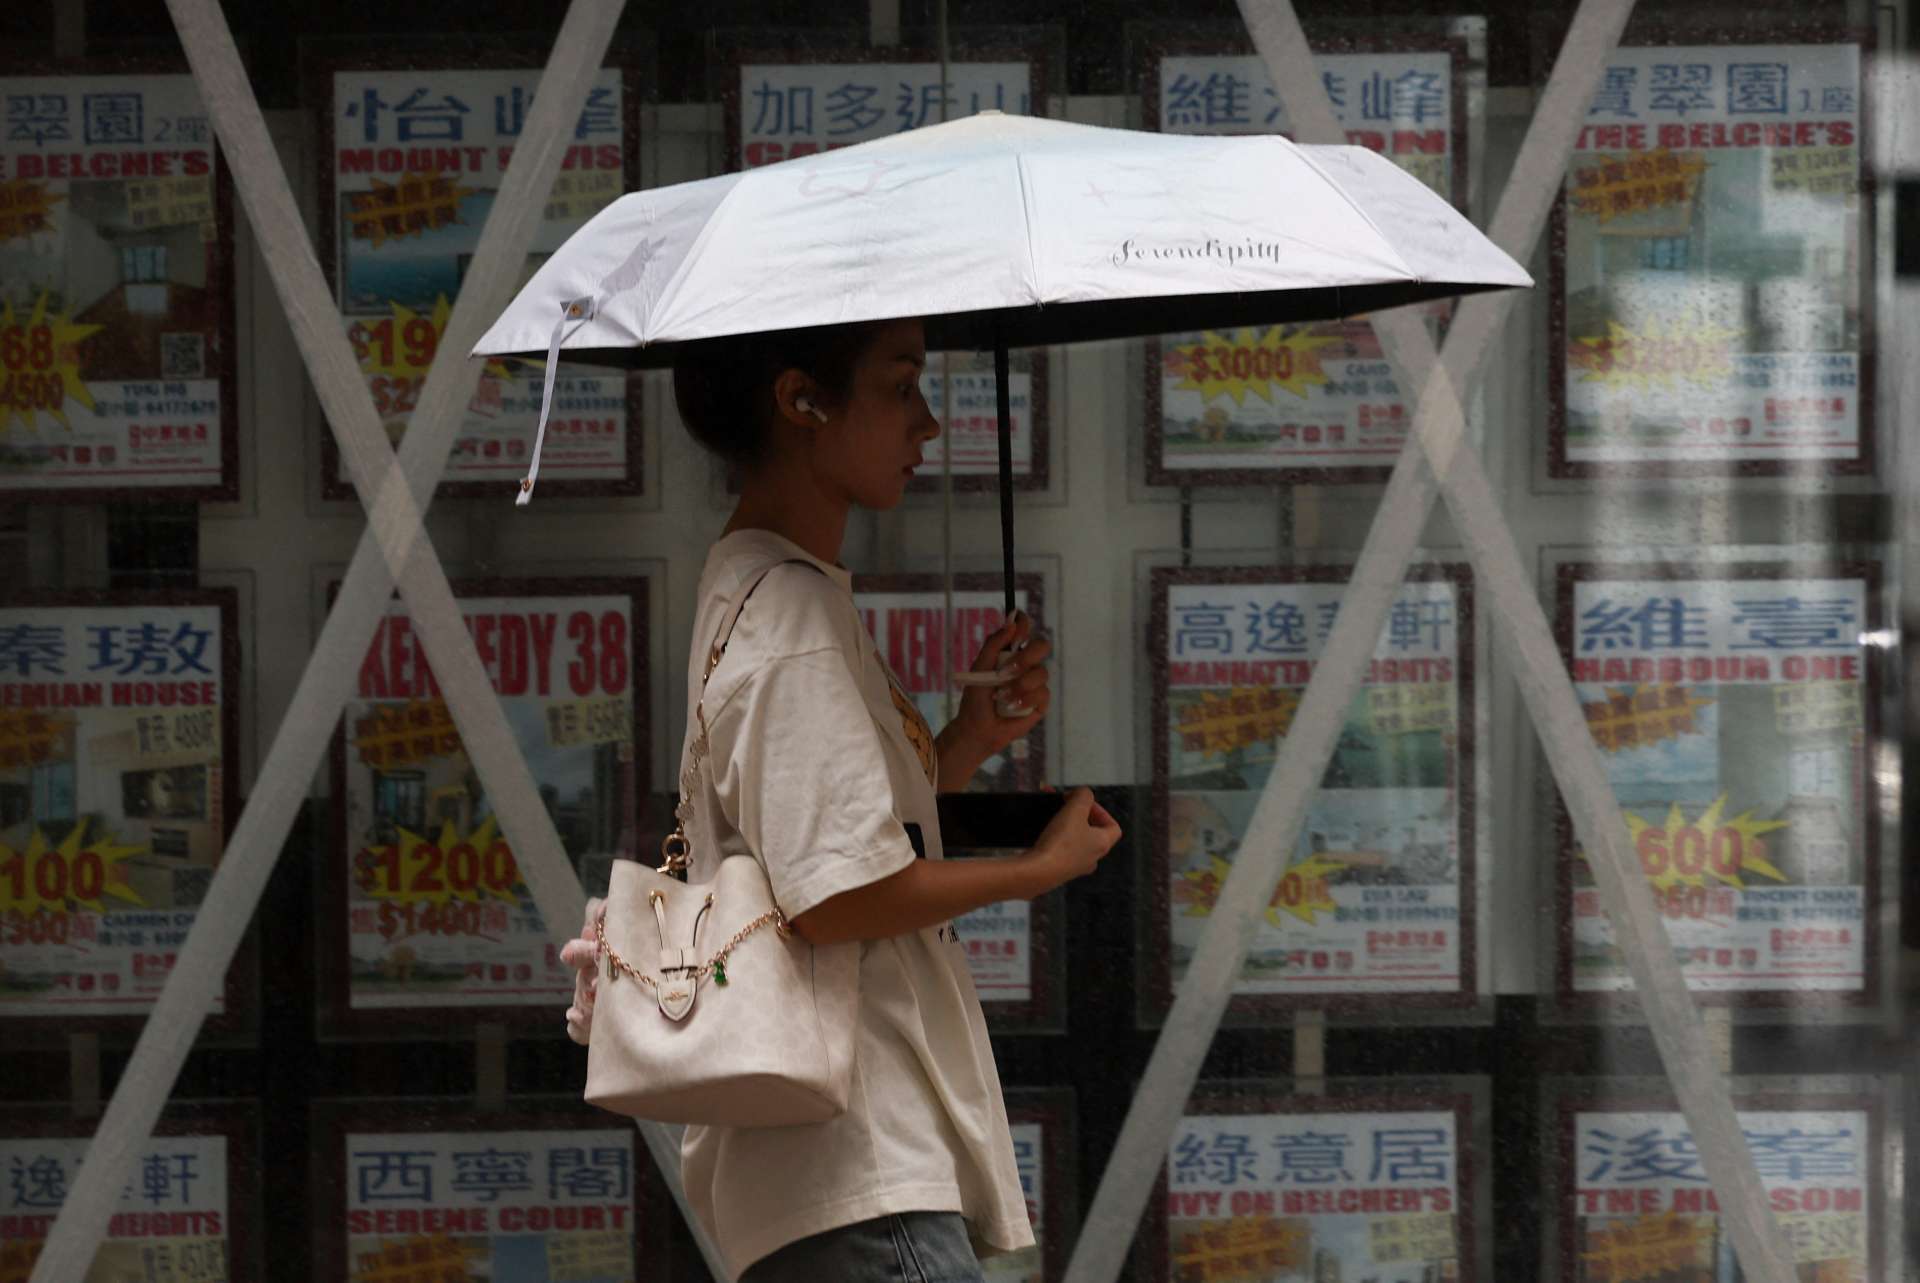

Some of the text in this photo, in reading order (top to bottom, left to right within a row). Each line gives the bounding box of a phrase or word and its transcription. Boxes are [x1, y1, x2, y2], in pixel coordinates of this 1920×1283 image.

[339, 145, 487, 174] MOUNT
[1112, 237, 1280, 267] Serendipity
[1581, 598, 1858, 651] 維壹
[567, 610, 627, 697] 38
[1169, 659, 1316, 686] MANHATTA
[1574, 655, 1861, 683] HARBOUR ONE
[112, 681, 217, 707] HOUSE
[1174, 1128, 1451, 1185] 綠意居
[353, 1147, 629, 1203] 西寧閣
[1230, 1190, 1275, 1216] ON
[1576, 1187, 1863, 1214] THE HSON
[349, 1204, 631, 1234] SERENE COURT
